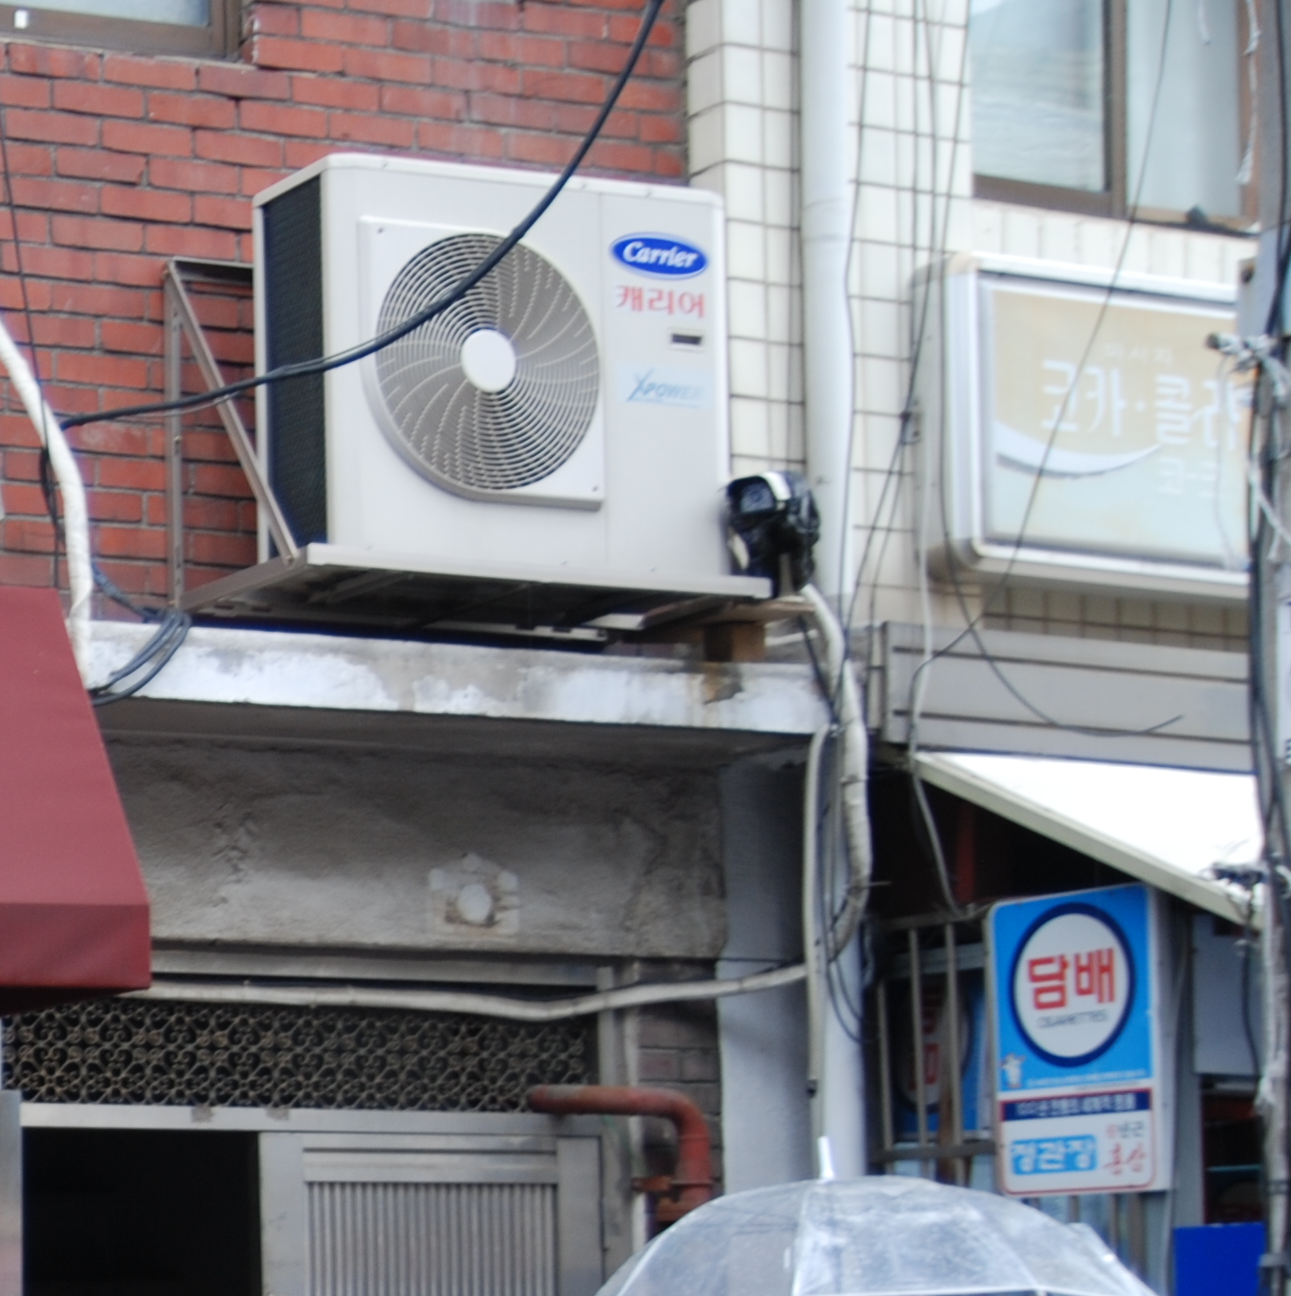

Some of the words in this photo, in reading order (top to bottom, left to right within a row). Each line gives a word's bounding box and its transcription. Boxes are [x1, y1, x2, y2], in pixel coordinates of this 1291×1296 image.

[621, 238, 702, 272] Carrier
[615, 285, 707, 319] 캐리어
[1026, 946, 1117, 1011] 담배
